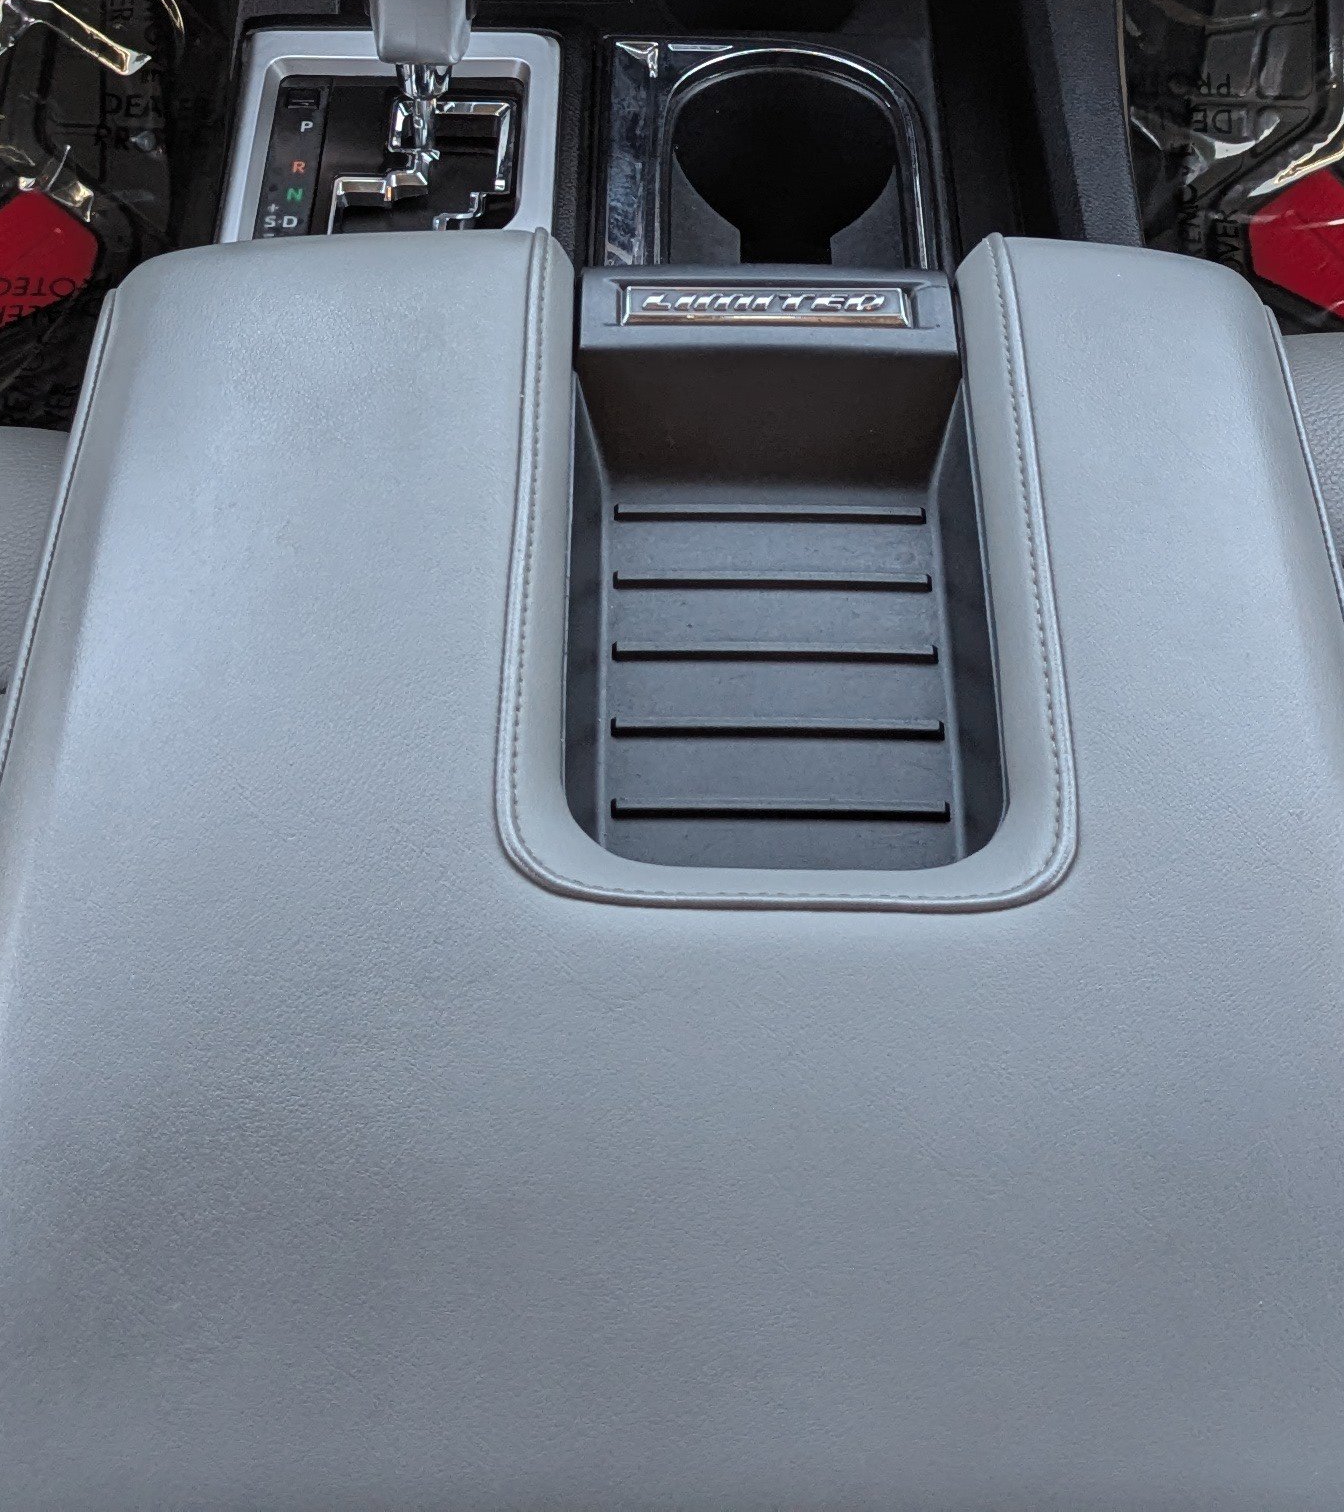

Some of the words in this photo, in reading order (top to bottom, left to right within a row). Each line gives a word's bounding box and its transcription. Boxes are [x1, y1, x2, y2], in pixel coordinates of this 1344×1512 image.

[300, 120, 314, 133] P
[292, 161, 306, 173] R
[286, 188, 303, 201] N
[642, 291, 886, 313] LIMITED
